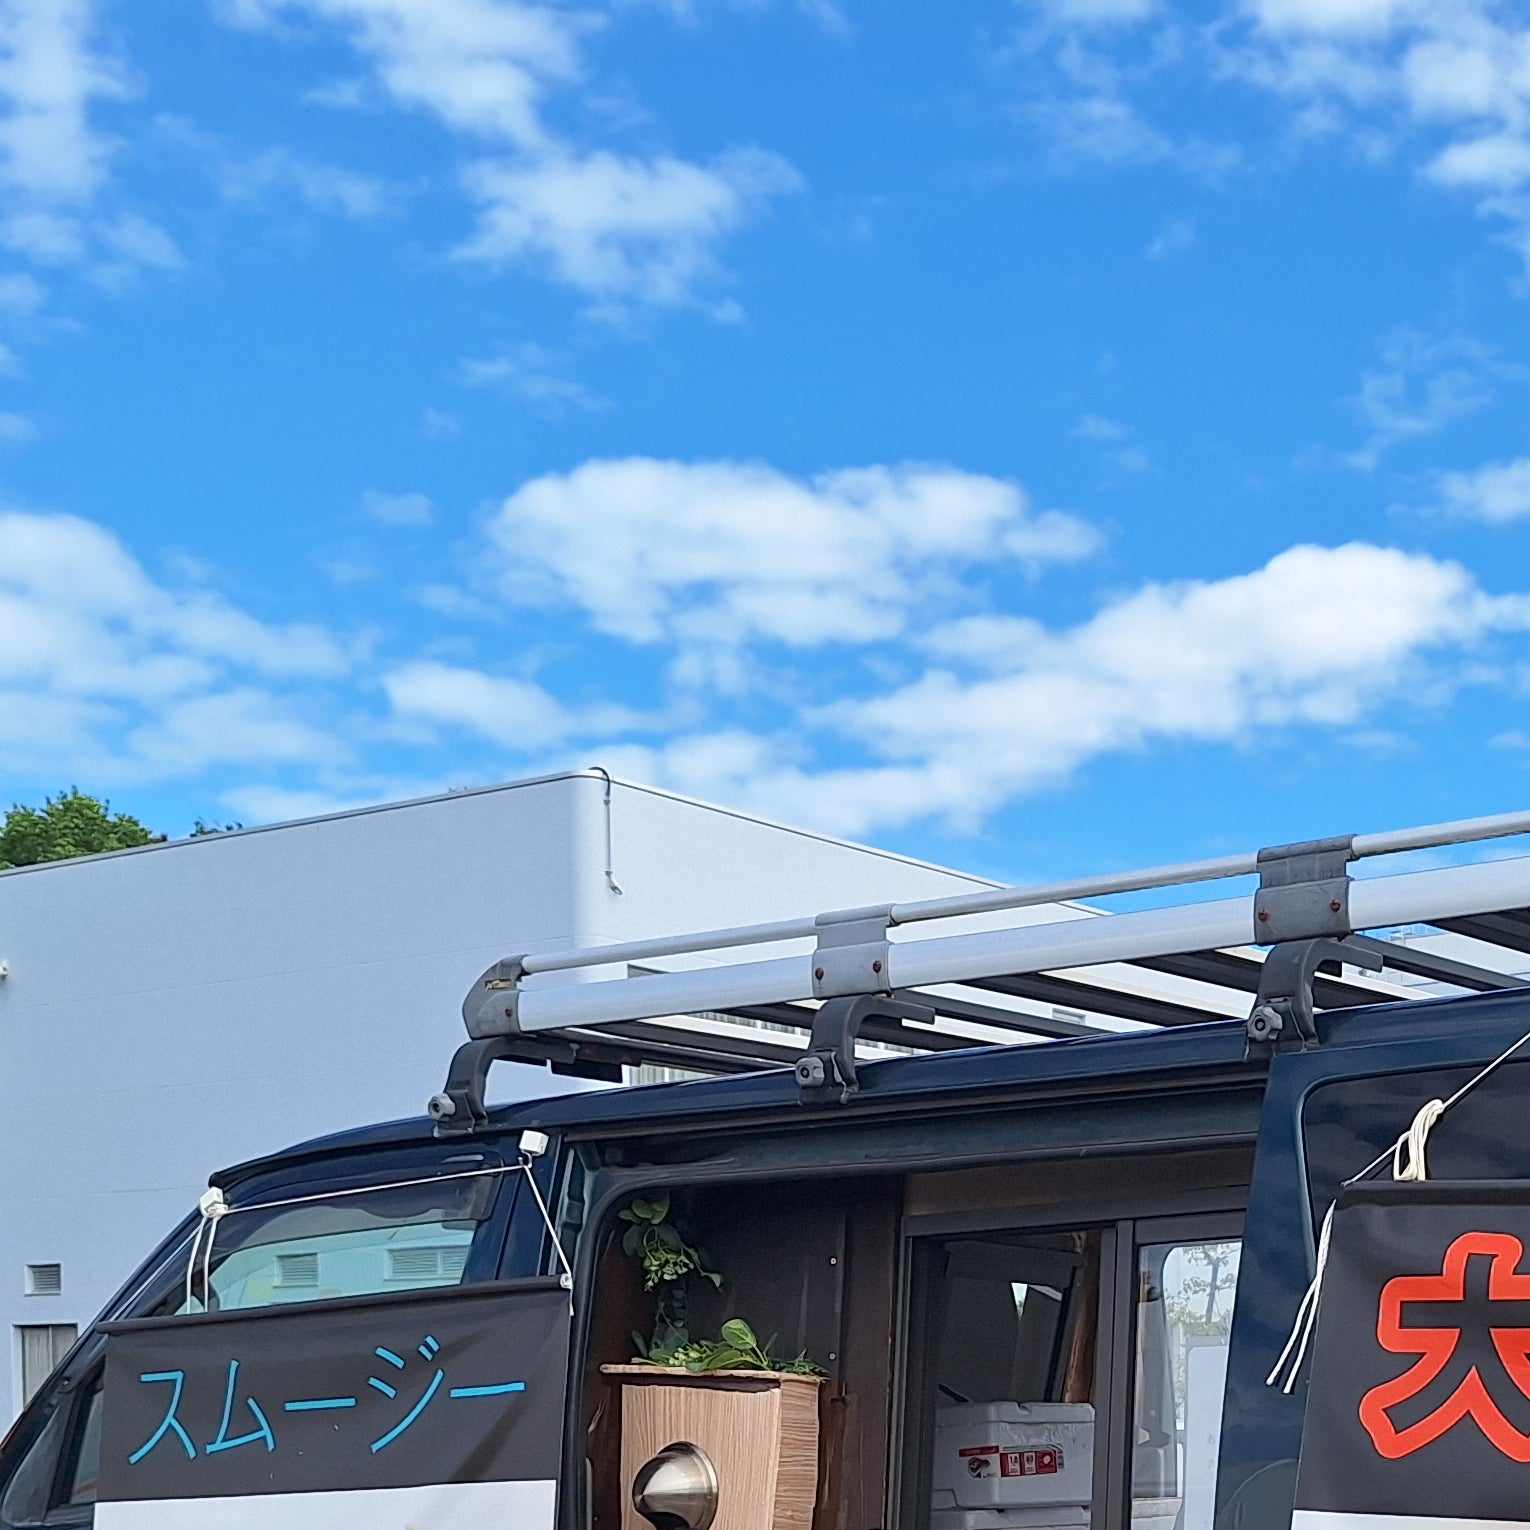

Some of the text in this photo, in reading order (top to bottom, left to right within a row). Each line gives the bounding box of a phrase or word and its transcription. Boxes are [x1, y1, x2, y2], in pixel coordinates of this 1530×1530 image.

[128, 1334, 526, 1465] スムージー
